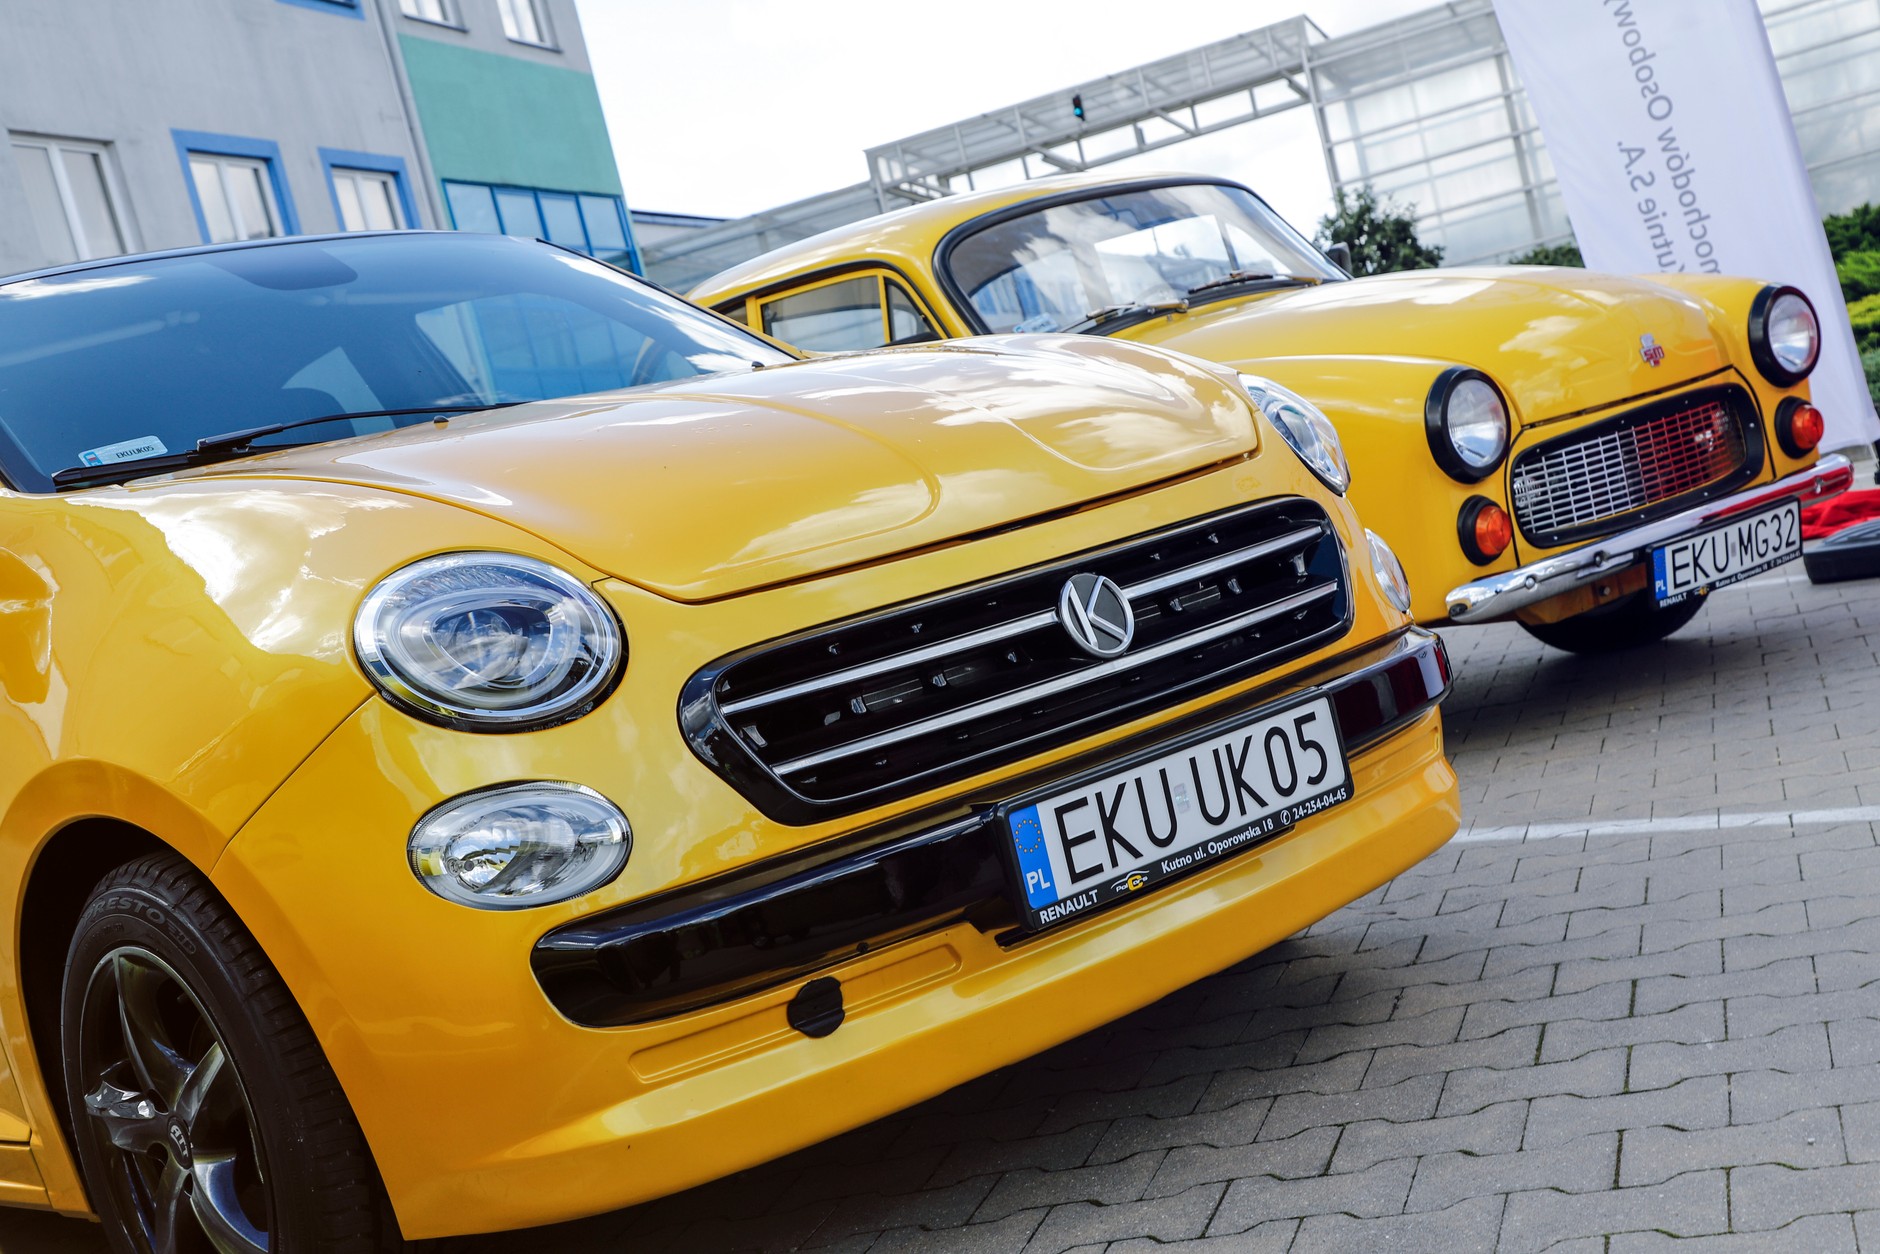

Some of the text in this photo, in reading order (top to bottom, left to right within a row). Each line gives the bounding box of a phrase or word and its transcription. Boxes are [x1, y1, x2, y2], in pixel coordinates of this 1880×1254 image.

[1672, 508, 1796, 589] EKU MG32
[1655, 578, 1666, 592] PL
[1054, 711, 1328, 885] EKU UK05
[1161, 788, 1347, 873] Kutno ul. Oporowska 18 24-254-04-45
[1026, 868, 1051, 895] PL
[1039, 889, 1098, 924] RENAULT
